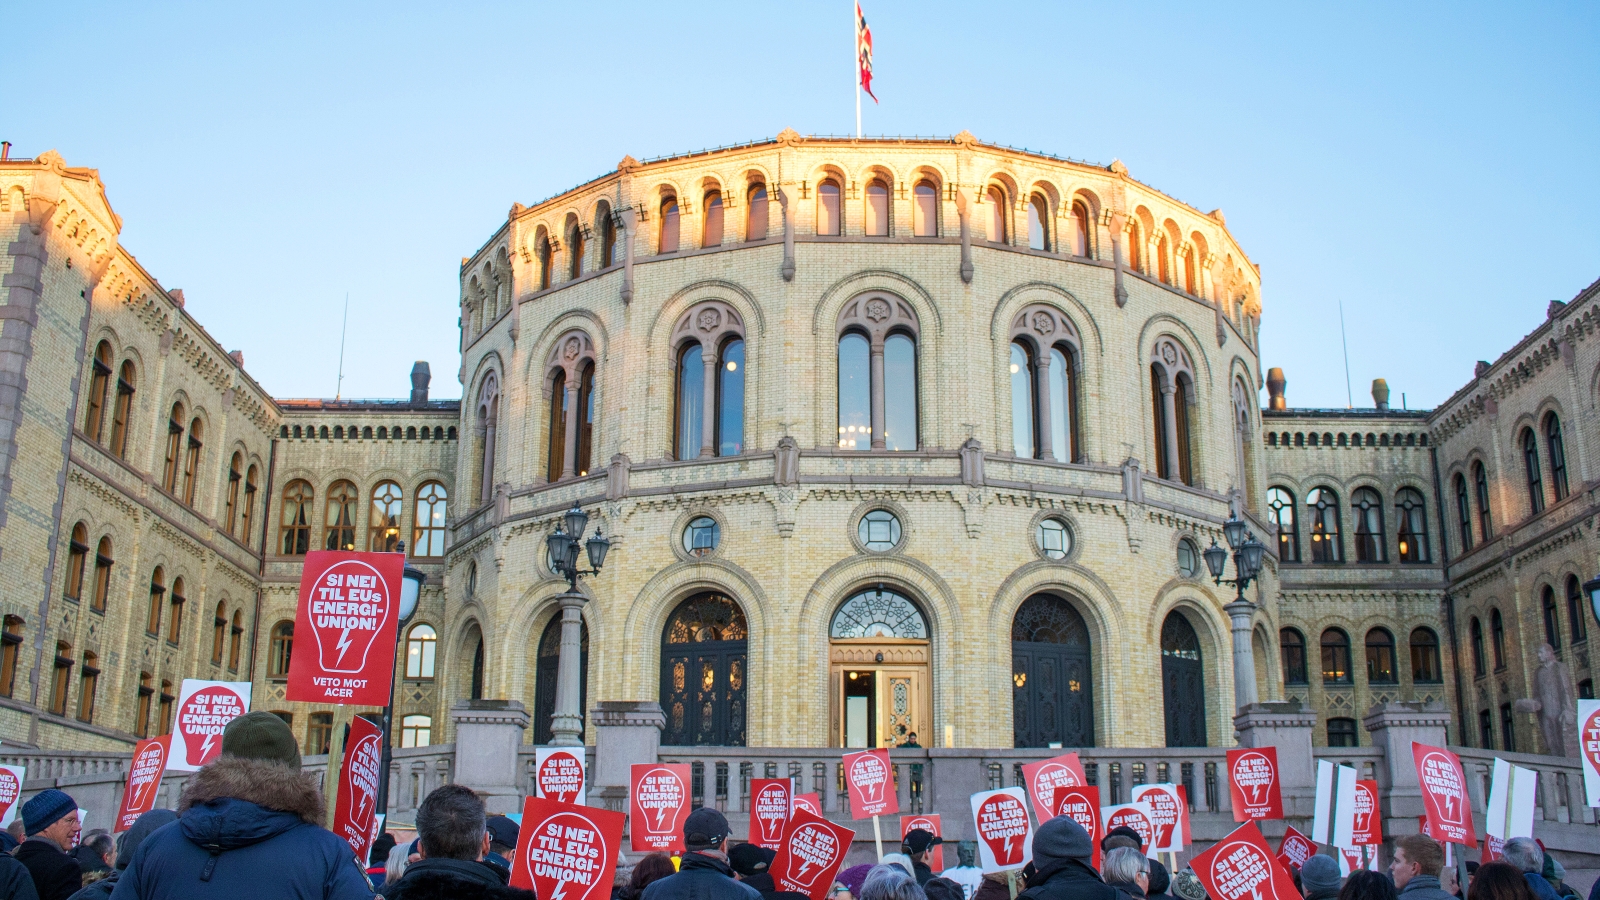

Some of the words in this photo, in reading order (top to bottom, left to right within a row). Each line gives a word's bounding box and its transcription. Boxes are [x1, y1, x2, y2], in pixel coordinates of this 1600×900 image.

[326, 574, 343, 588] SI
[346, 575, 377, 588] NEI
[318, 588, 345, 601] TIL
[312, 601, 384, 616] ENERGI-
[317, 617, 377, 630] UNION!
[313, 677, 341, 686] VETO
[343, 679, 368, 689] MOT
[324, 687, 353, 697] ACER
[195, 694, 210, 705] SI
[211, 694, 237, 705] NEI
[187, 704, 209, 715] TIL
[212, 705, 241, 716] EUS
[547, 759, 557, 767] SI
[558, 758, 576, 767] NEI
[864, 759, 879, 767] NEI
[1250, 758, 1266, 766] NEI
[1427, 759, 1438, 769] SI
[1438, 762, 1453, 772] NEI
[543, 767, 559, 776] TIL
[853, 771, 886, 781] ENERGI-
[1039, 773, 1050, 783] SI
[1050, 768, 1068, 780] NEI
[1236, 771, 1272, 781] ENERGI-
[1425, 766, 1441, 777] TIL
[541, 775, 582, 784] ENERGI-
[646, 776, 656, 785] SI
[657, 776, 676, 785] NEI
[857, 776, 884, 787] UNION!
[1239, 778, 1270, 787] UNION!
[1425, 775, 1461, 789] ENERGI-
[544, 784, 578, 793] UNION!
[641, 784, 659, 793] TIL
[1038, 782, 1055, 791] TIL
[1430, 784, 1461, 799] UNION!
[640, 792, 682, 801] ENERGI-
[763, 790, 772, 798] SI
[772, 790, 785, 798] NEI
[1142, 795, 1152, 803] SI
[642, 800, 679, 809] UNION!
[985, 803, 997, 813] SI
[998, 800, 1018, 811] NEI
[1063, 803, 1071, 812] SI
[1072, 803, 1087, 812] NEI
[981, 812, 1000, 822] TIL
[1001, 808, 1024, 819] EUS
[1112, 816, 1123, 825] SI
[1124, 813, 1142, 823] NEI
[1151, 809, 1177, 818] ERGI-
[981, 817, 1027, 832] ENERGI-
[1439, 823, 1455, 832] VETO
[546, 823, 563, 838] SI
[565, 826, 595, 844] NEI
[799, 831, 813, 846] TIL
[804, 826, 816, 837] SI
[815, 831, 835, 845] NEI
[985, 827, 1026, 840] UNION!
[538, 834, 563, 852] TIL
[792, 837, 834, 860] ENERGI-
[531, 848, 600, 872] ENERGI-
[792, 846, 828, 868] UNION!
[1215, 858, 1230, 873] SI
[1228, 845, 1250, 865] NEI
[534, 862, 592, 886] UNION!
[1216, 867, 1238, 884] TIL
[1219, 861, 1266, 894] ENERGI-
[780, 878, 797, 891] VETO
[796, 887, 811, 897] MOT
[1228, 869, 1269, 900] UNION!
